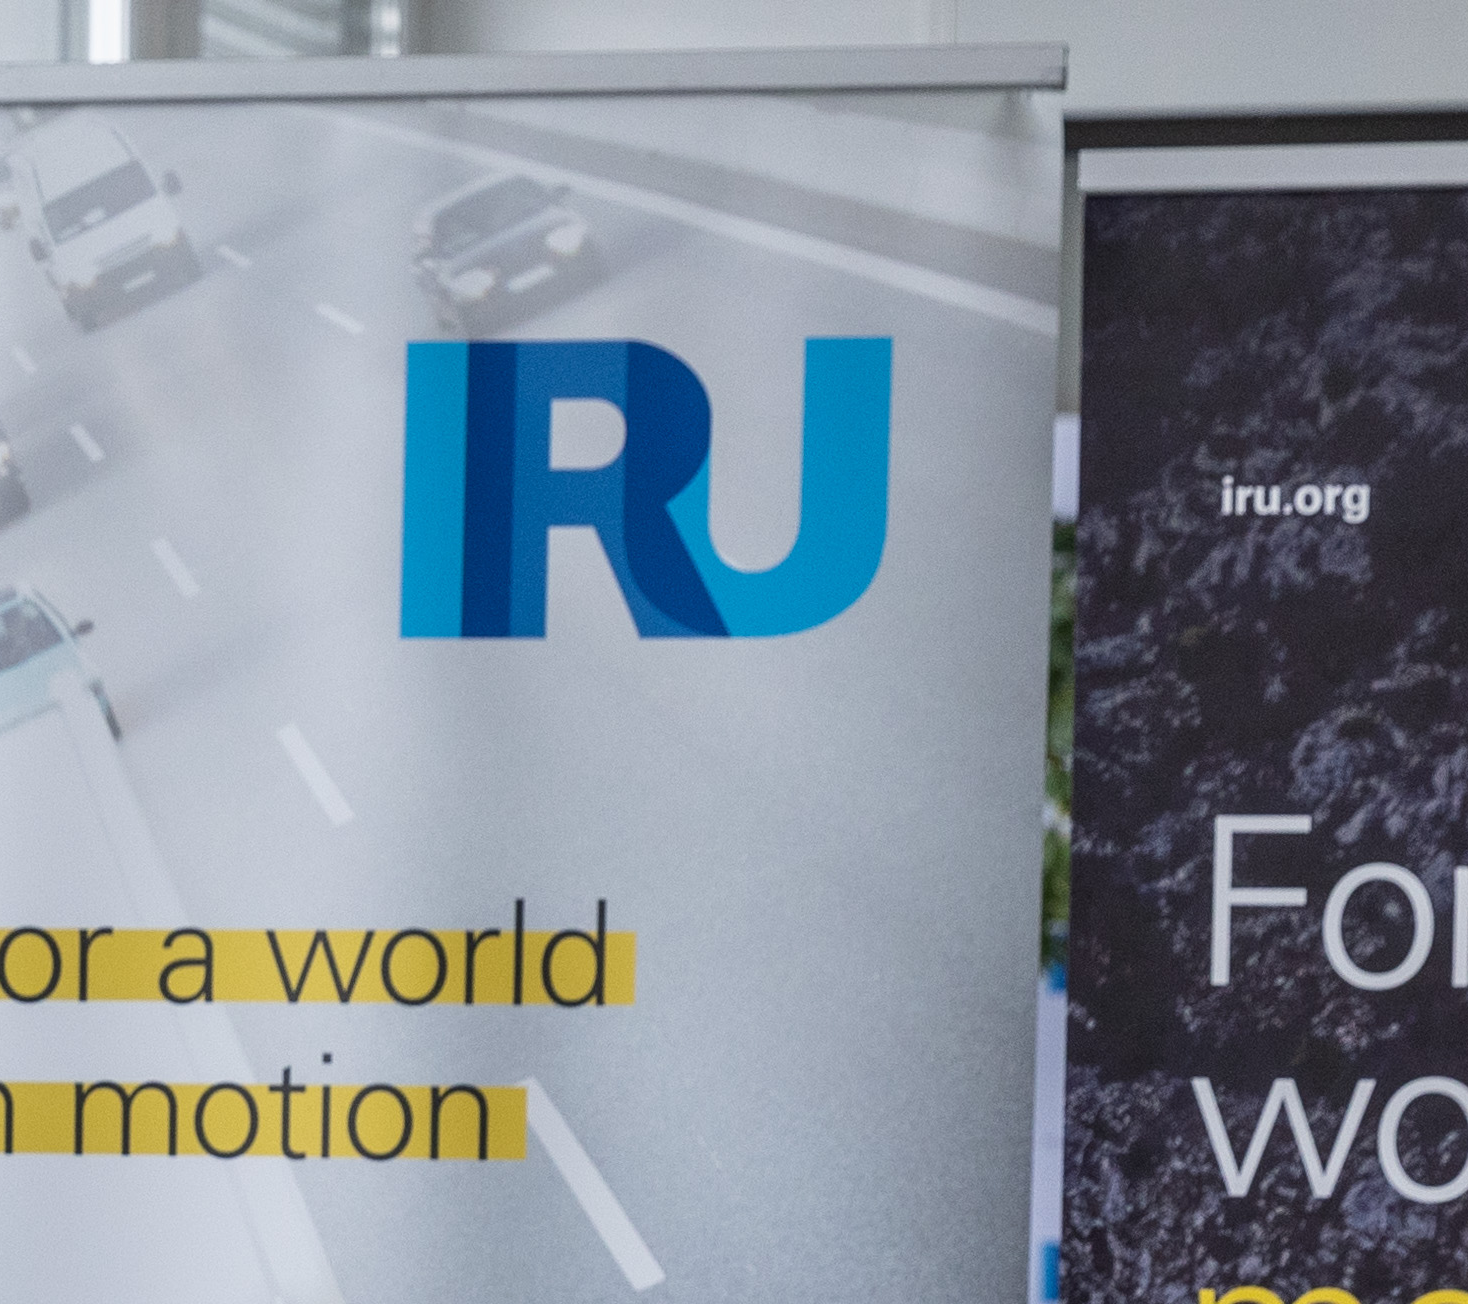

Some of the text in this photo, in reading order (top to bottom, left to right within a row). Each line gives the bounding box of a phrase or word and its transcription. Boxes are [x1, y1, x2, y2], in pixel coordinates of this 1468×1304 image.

[400, 336, 893, 639] IRU
[1220, 473, 1371, 523] iru.org
[157, 926, 215, 1005] a
[265, 898, 607, 1008] world
[73, 1051, 490, 1162] motion
